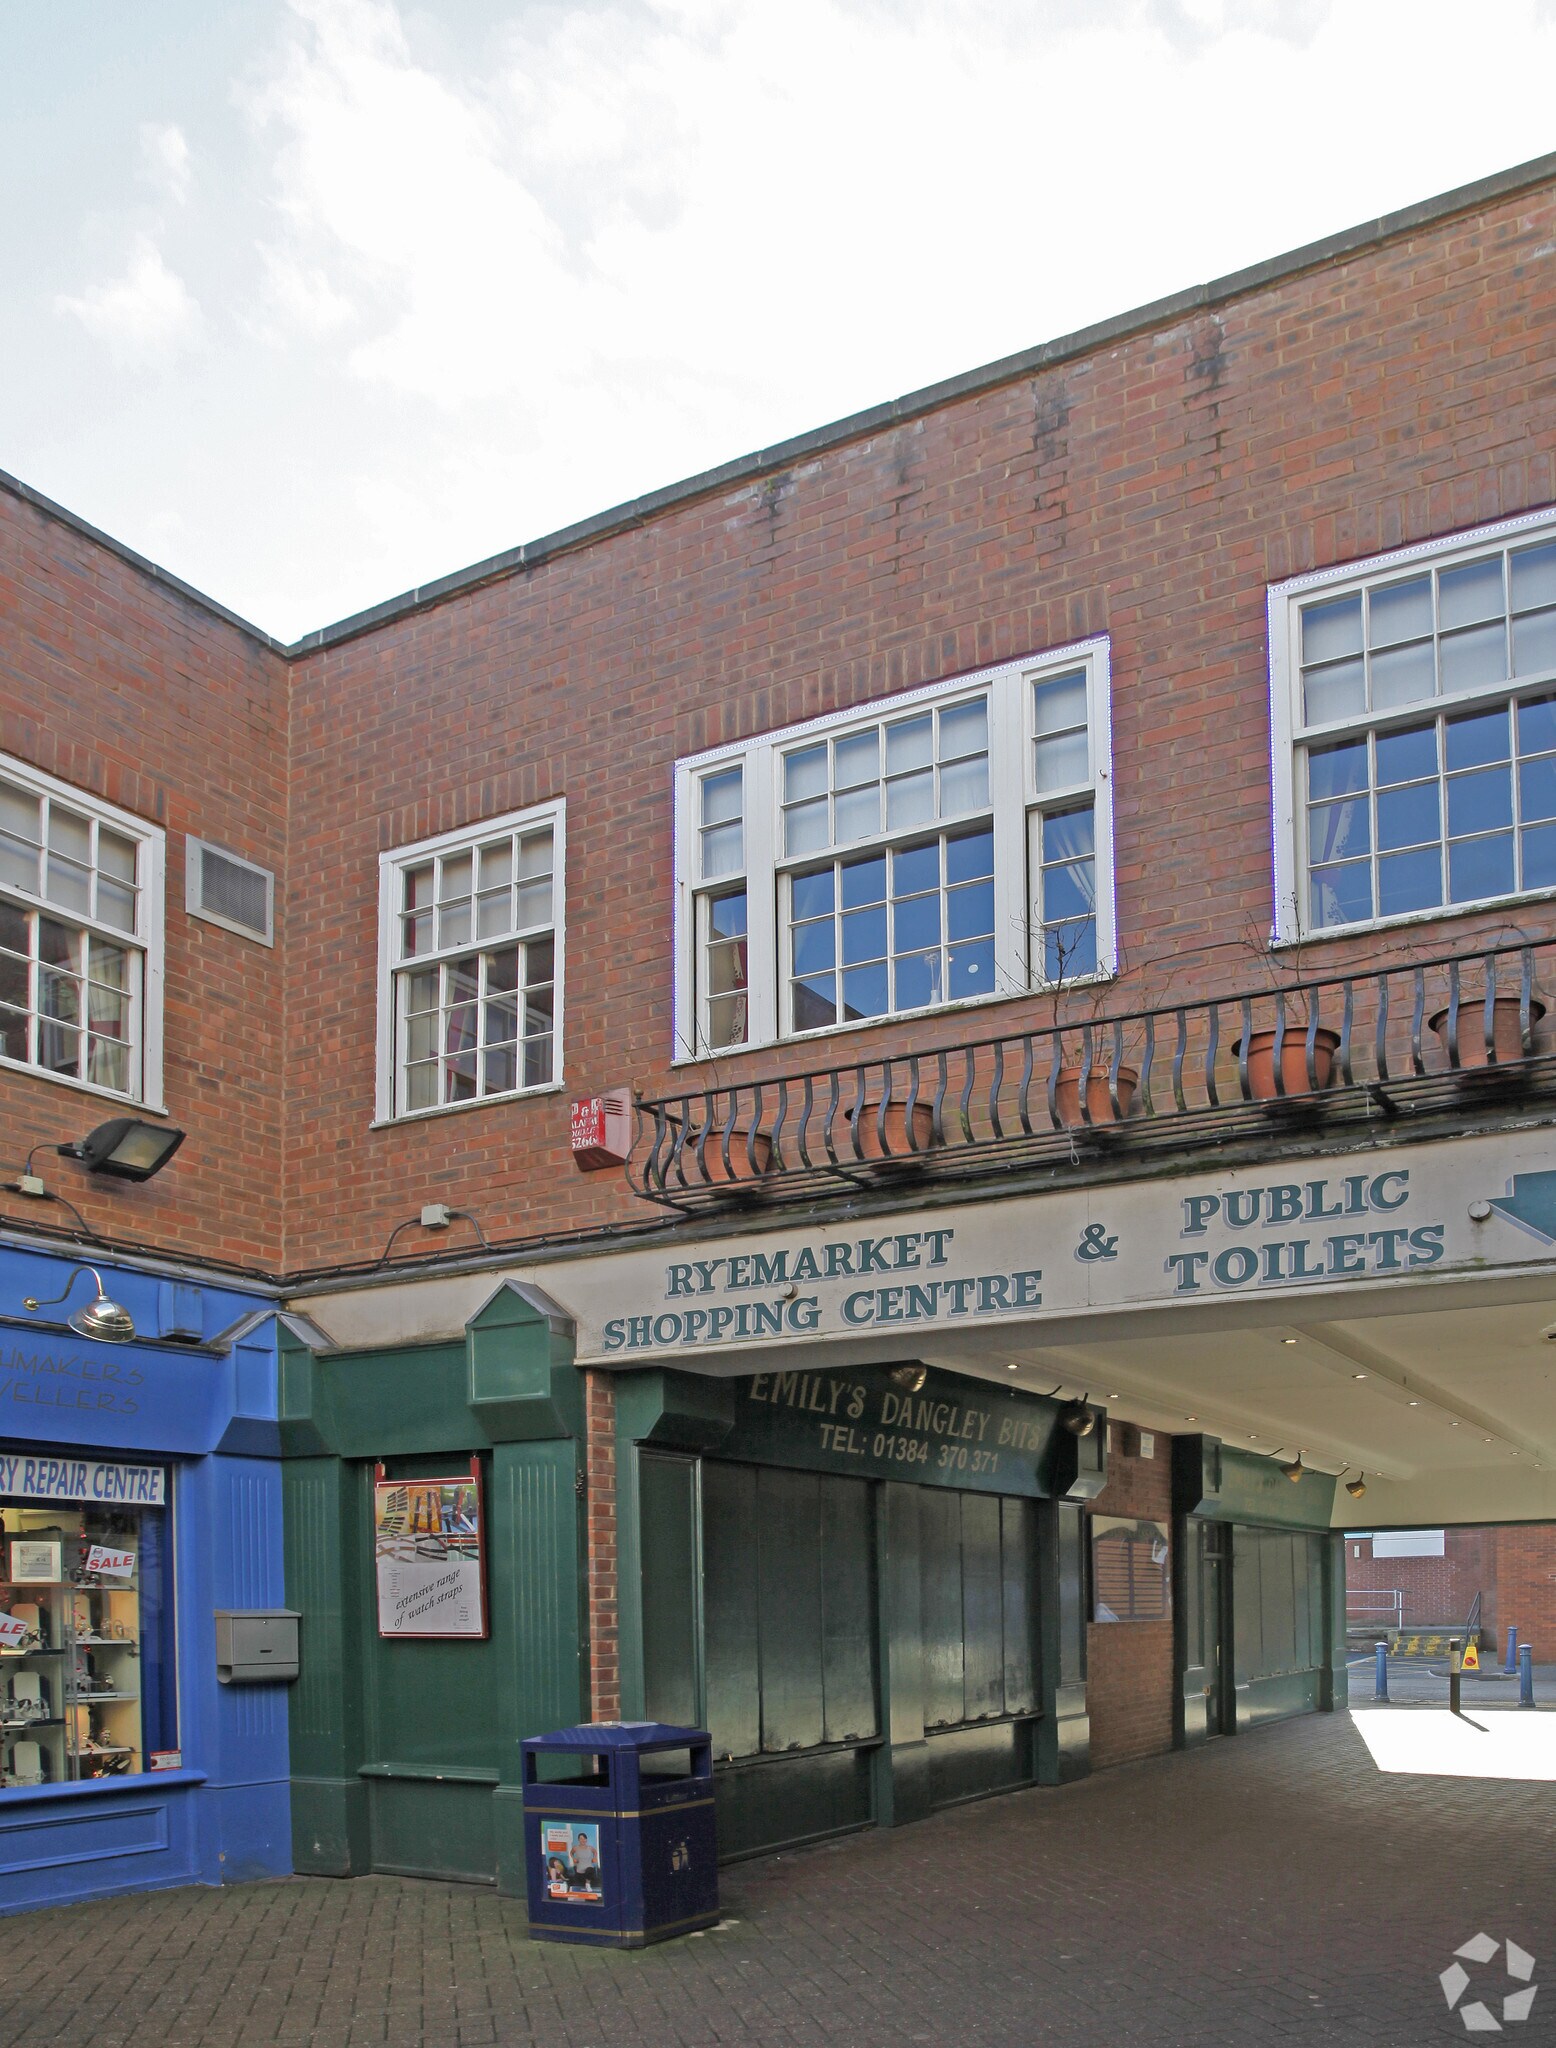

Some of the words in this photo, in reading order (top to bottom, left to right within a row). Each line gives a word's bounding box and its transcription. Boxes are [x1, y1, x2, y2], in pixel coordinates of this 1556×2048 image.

[1181, 1169, 1410, 1238] PUBLIC
[667, 1228, 954, 1297] RYEMARKET
[1075, 1222, 1119, 1262] &
[1165, 1224, 1445, 1294] TOILETS
[603, 1296, 823, 1352] SHOPPING
[843, 1270, 1043, 1327] CENTRE
[749, 1372, 867, 1419] EMILY'S
[881, 1392, 992, 1441] DANGLEY
[998, 1417, 1043, 1451] BITS
[820, 1423, 867, 1455] TEL:
[873, 1433, 928, 1464] 01384
[938, 1444, 967, 1470] 370
[971, 1450, 999, 1473] 371
[23, 1459, 88, 1497] REPAIR
[93, 1464, 160, 1501] CENTRE
[89, 1554, 134, 1571] SALE
[395, 1583, 435, 1610] extensive
[436, 1568, 461, 1587] range
[394, 1610, 405, 1630] of
[407, 1595, 435, 1619] watch
[436, 1584, 463, 1605] straps
